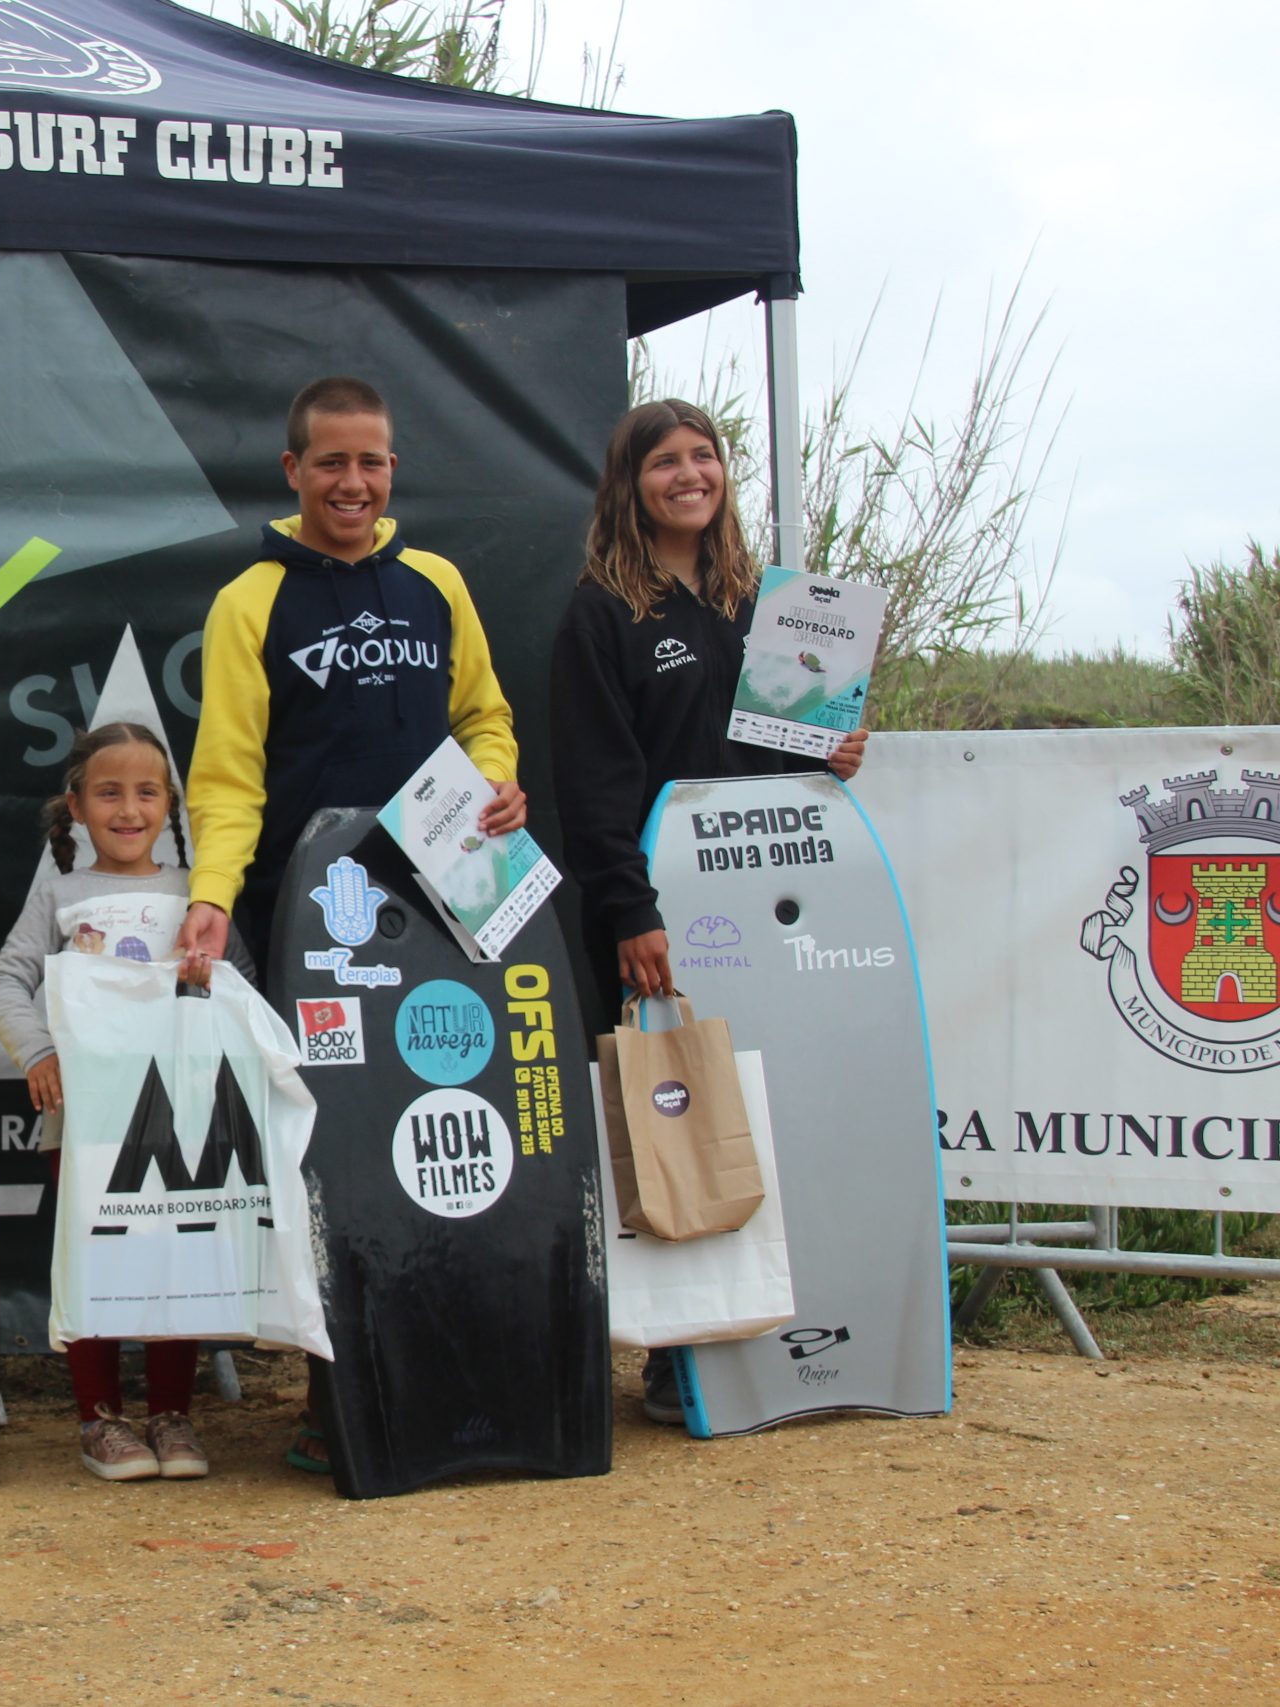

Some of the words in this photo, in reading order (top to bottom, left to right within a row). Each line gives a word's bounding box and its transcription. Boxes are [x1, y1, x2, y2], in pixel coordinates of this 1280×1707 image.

[156, 120, 343, 188] CLUBE
[777, 615, 855, 640] BODYBOARD
[656, 653, 697, 672] 4MENTAL
[423, 791, 472, 847] BODYBOARD
[719, 805, 823, 837] PRIDE
[697, 844, 762, 872] nova
[769, 836, 834, 866] onda
[679, 956, 752, 968] 4MENTAL
[408, 1003, 484, 1034] NATUR
[505, 964, 556, 1061] OFS
[308, 1030, 356, 1048] BODY
[408, 1032, 487, 1058] navega
[1123, 995, 1236, 1065] MUNICÍPIO
[1240, 1044, 1273, 1064] DE
[308, 1047, 357, 1061] BOARD
[532, 1066, 546, 1100] FATO
[546, 1065, 562, 1116] OFICINA
[535, 1101, 548, 1118] DE
[411, 1109, 492, 1163] WOW
[537, 1120, 552, 1154] SURF
[552, 1117, 564, 1137] DO
[417, 1162, 495, 1198] FILMES
[99, 1203, 164, 1216] MIRAMAR
[167, 1198, 247, 1214] BODYBOARD
